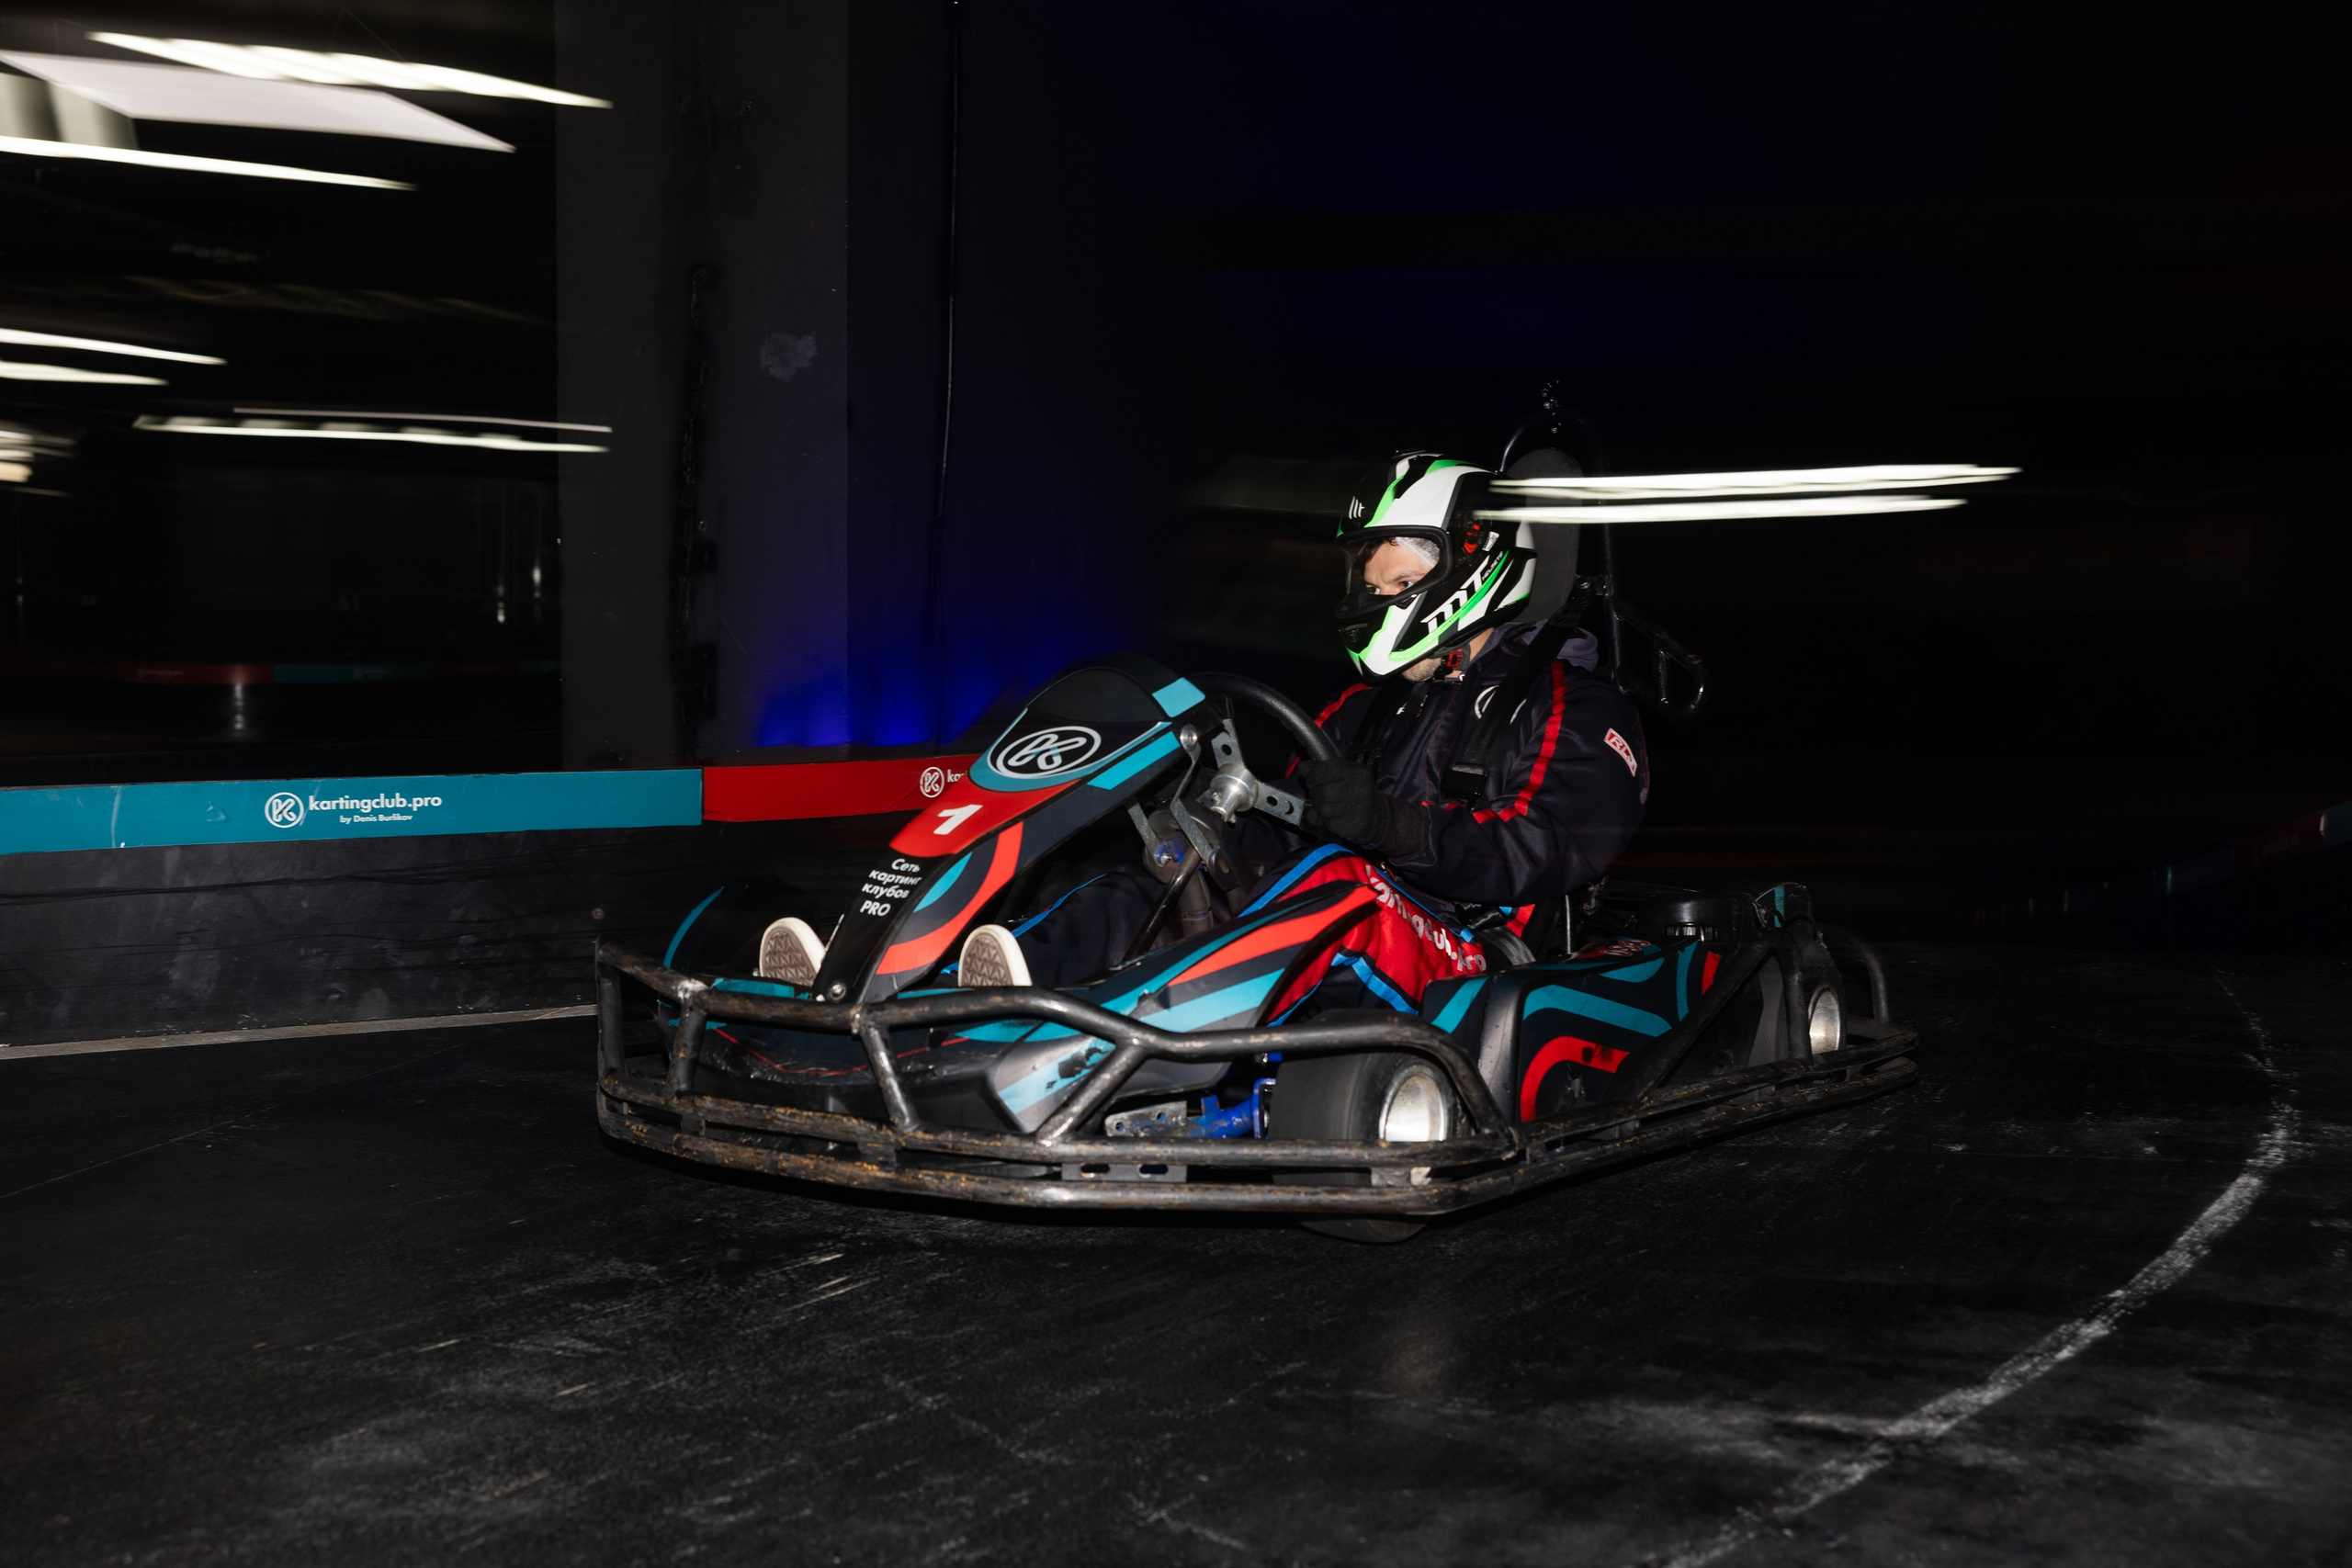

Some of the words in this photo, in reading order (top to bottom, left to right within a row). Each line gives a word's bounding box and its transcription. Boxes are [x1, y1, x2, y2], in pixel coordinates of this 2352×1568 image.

[309, 793, 442, 813] kartingclub.pro
[340, 815, 352, 825] by
[353, 814, 377, 822] Denis
[933, 804, 983, 835] 1
[891, 858, 921, 873] Сеть
[868, 869, 922, 885] картинг
[862, 883, 910, 899] клубов
[860, 900, 891, 917] PRO
